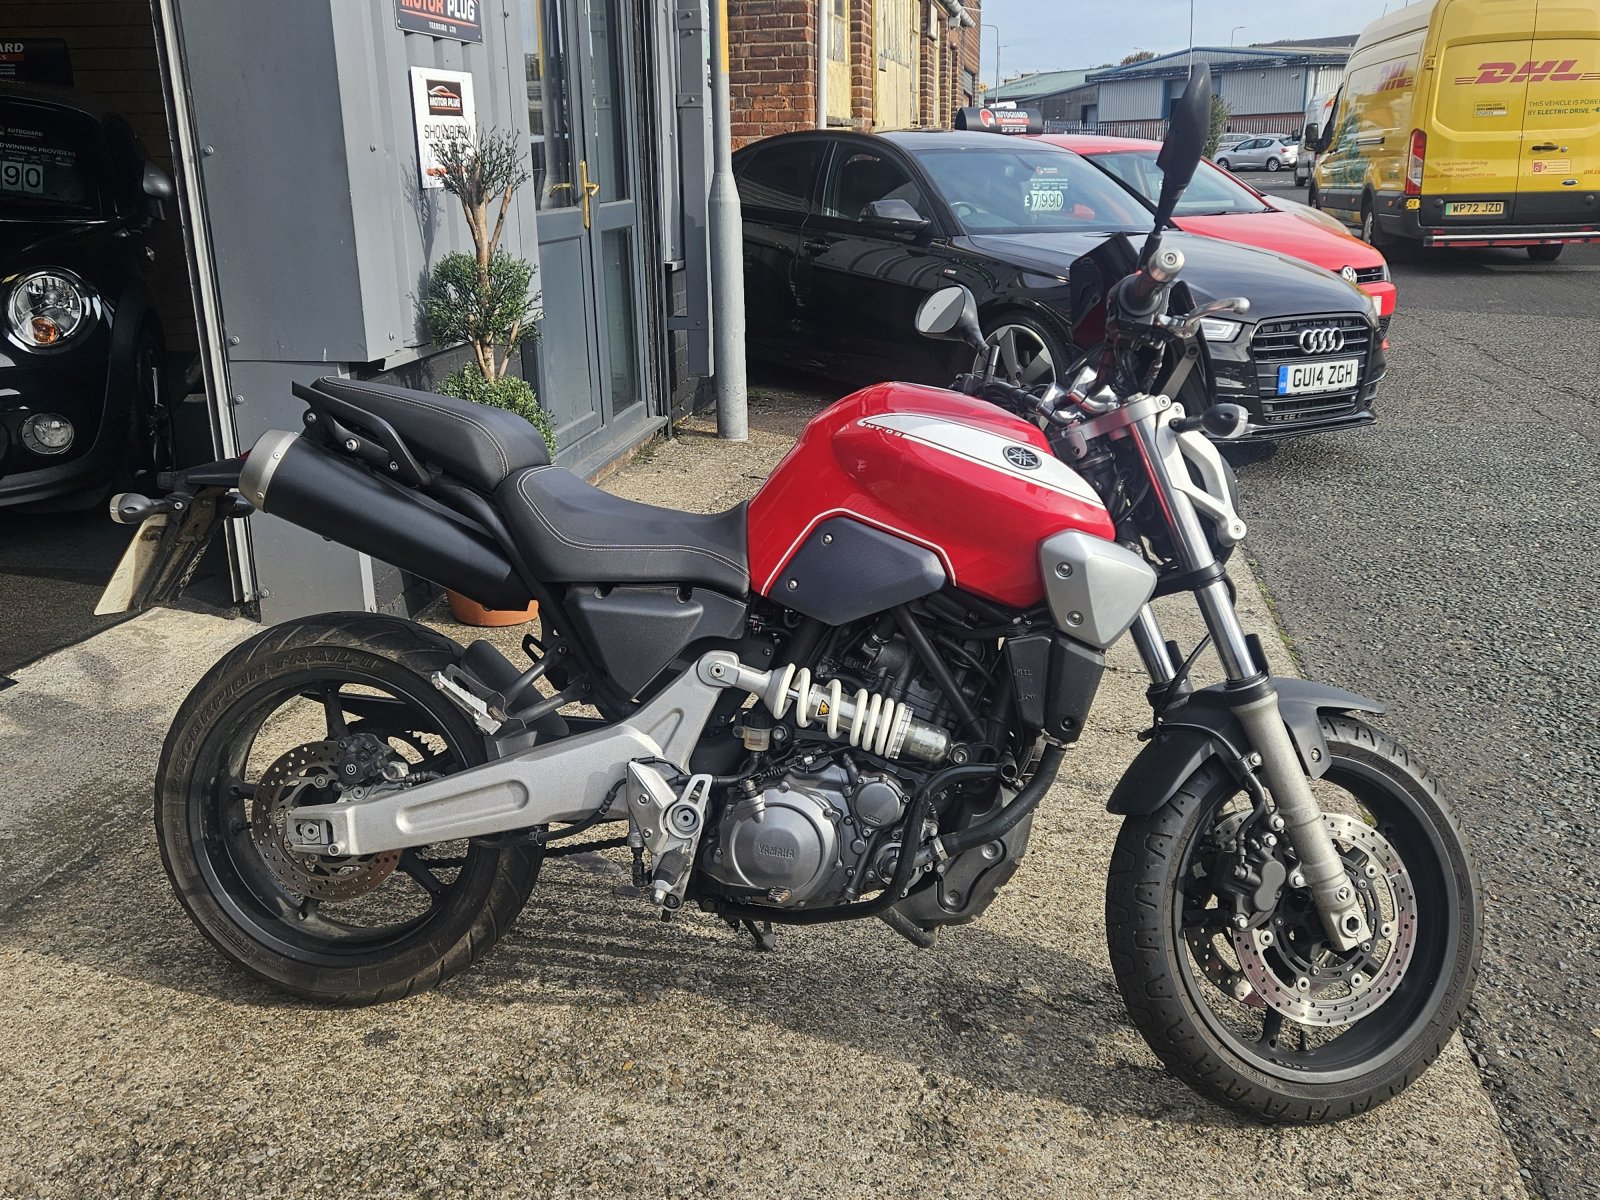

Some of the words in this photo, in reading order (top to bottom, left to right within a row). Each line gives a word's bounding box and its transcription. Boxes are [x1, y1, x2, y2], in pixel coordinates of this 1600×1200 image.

[447, 0, 475, 21] PLUG
[1474, 60, 1583, 84] DHL
[429, 96, 447, 107] MOTOR
[447, 97, 460, 107] PLUG
[996, 110, 1028, 119] AUTOGUARD
[7, 127, 43, 137] AUTOGUARD
[5, 143, 38, 152] WINNING
[38, 147, 76, 157] PROVIDERS
[1453, 203, 1479, 213] WP72
[1481, 202, 1502, 213] JZD
[1292, 366, 1325, 388] GU14
[1328, 363, 1353, 385] ZGH
[758, 843, 795, 860] YAMAHA
